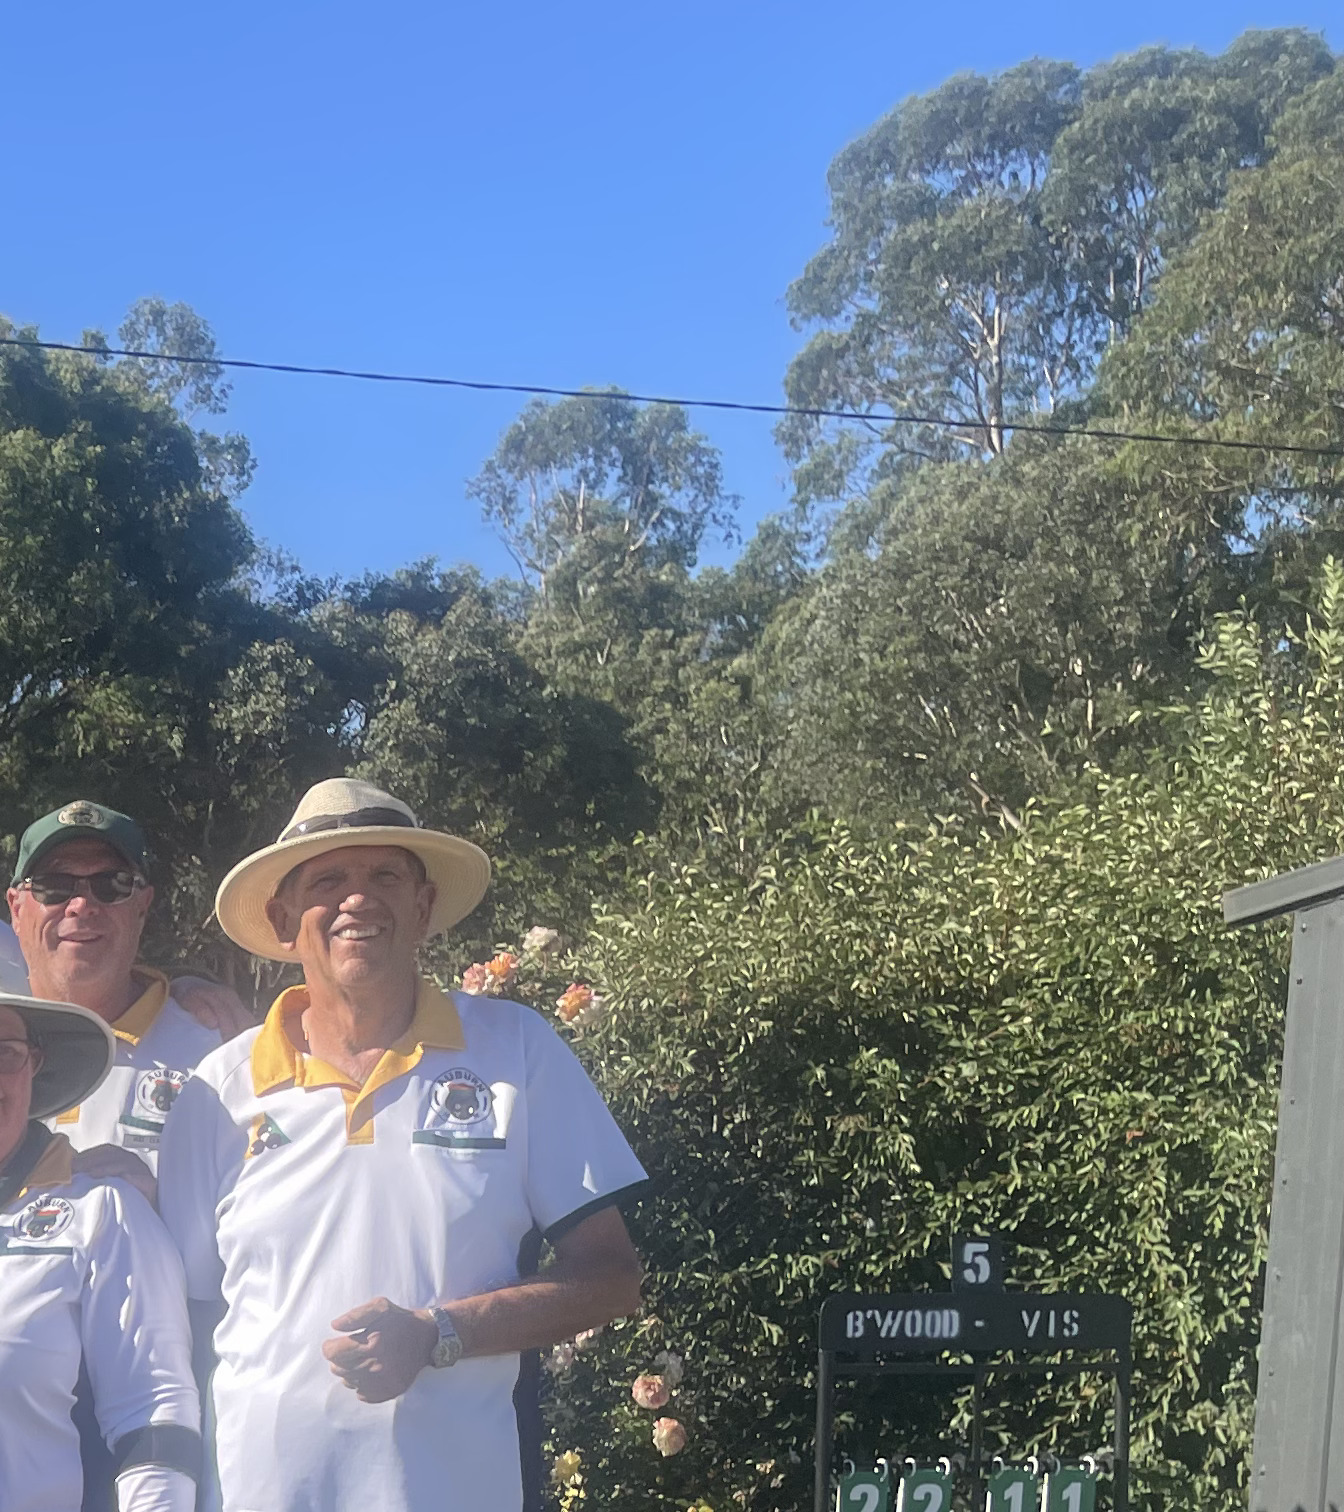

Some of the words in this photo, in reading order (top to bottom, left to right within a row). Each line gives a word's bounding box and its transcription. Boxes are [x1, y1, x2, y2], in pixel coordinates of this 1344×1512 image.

[962, 1242, 991, 1284] 5
[846, 1309, 960, 1339] B'WOOD
[1020, 1309, 1080, 1338] VIS
